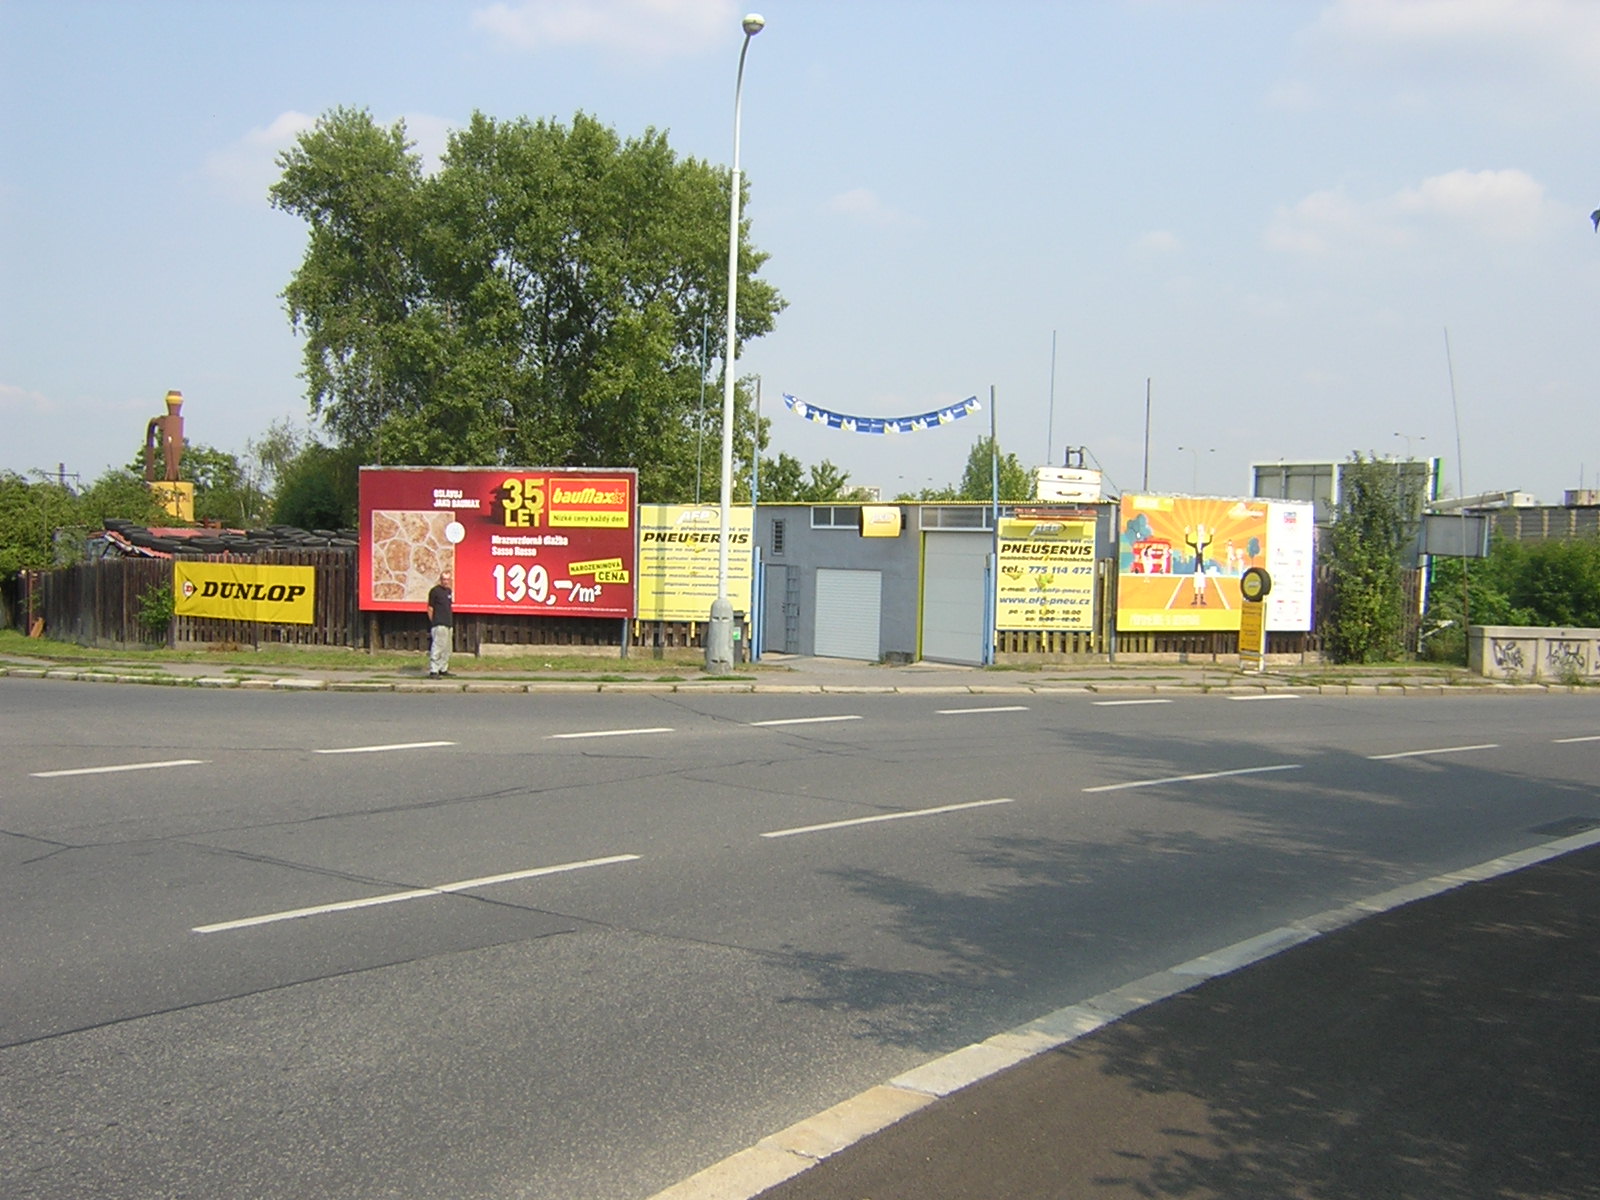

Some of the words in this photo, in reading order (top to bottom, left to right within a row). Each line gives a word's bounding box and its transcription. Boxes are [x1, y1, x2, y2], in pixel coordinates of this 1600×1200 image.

[502, 479, 545, 510] 35
[505, 508, 544, 527] LET
[643, 533, 749, 544] PNEUSERIS
[1001, 544, 1092, 555] PNEUSERVIS
[597, 571, 626, 582] CENA
[1071, 567, 1093, 575] 472
[201, 581, 305, 602] DUNLOP
